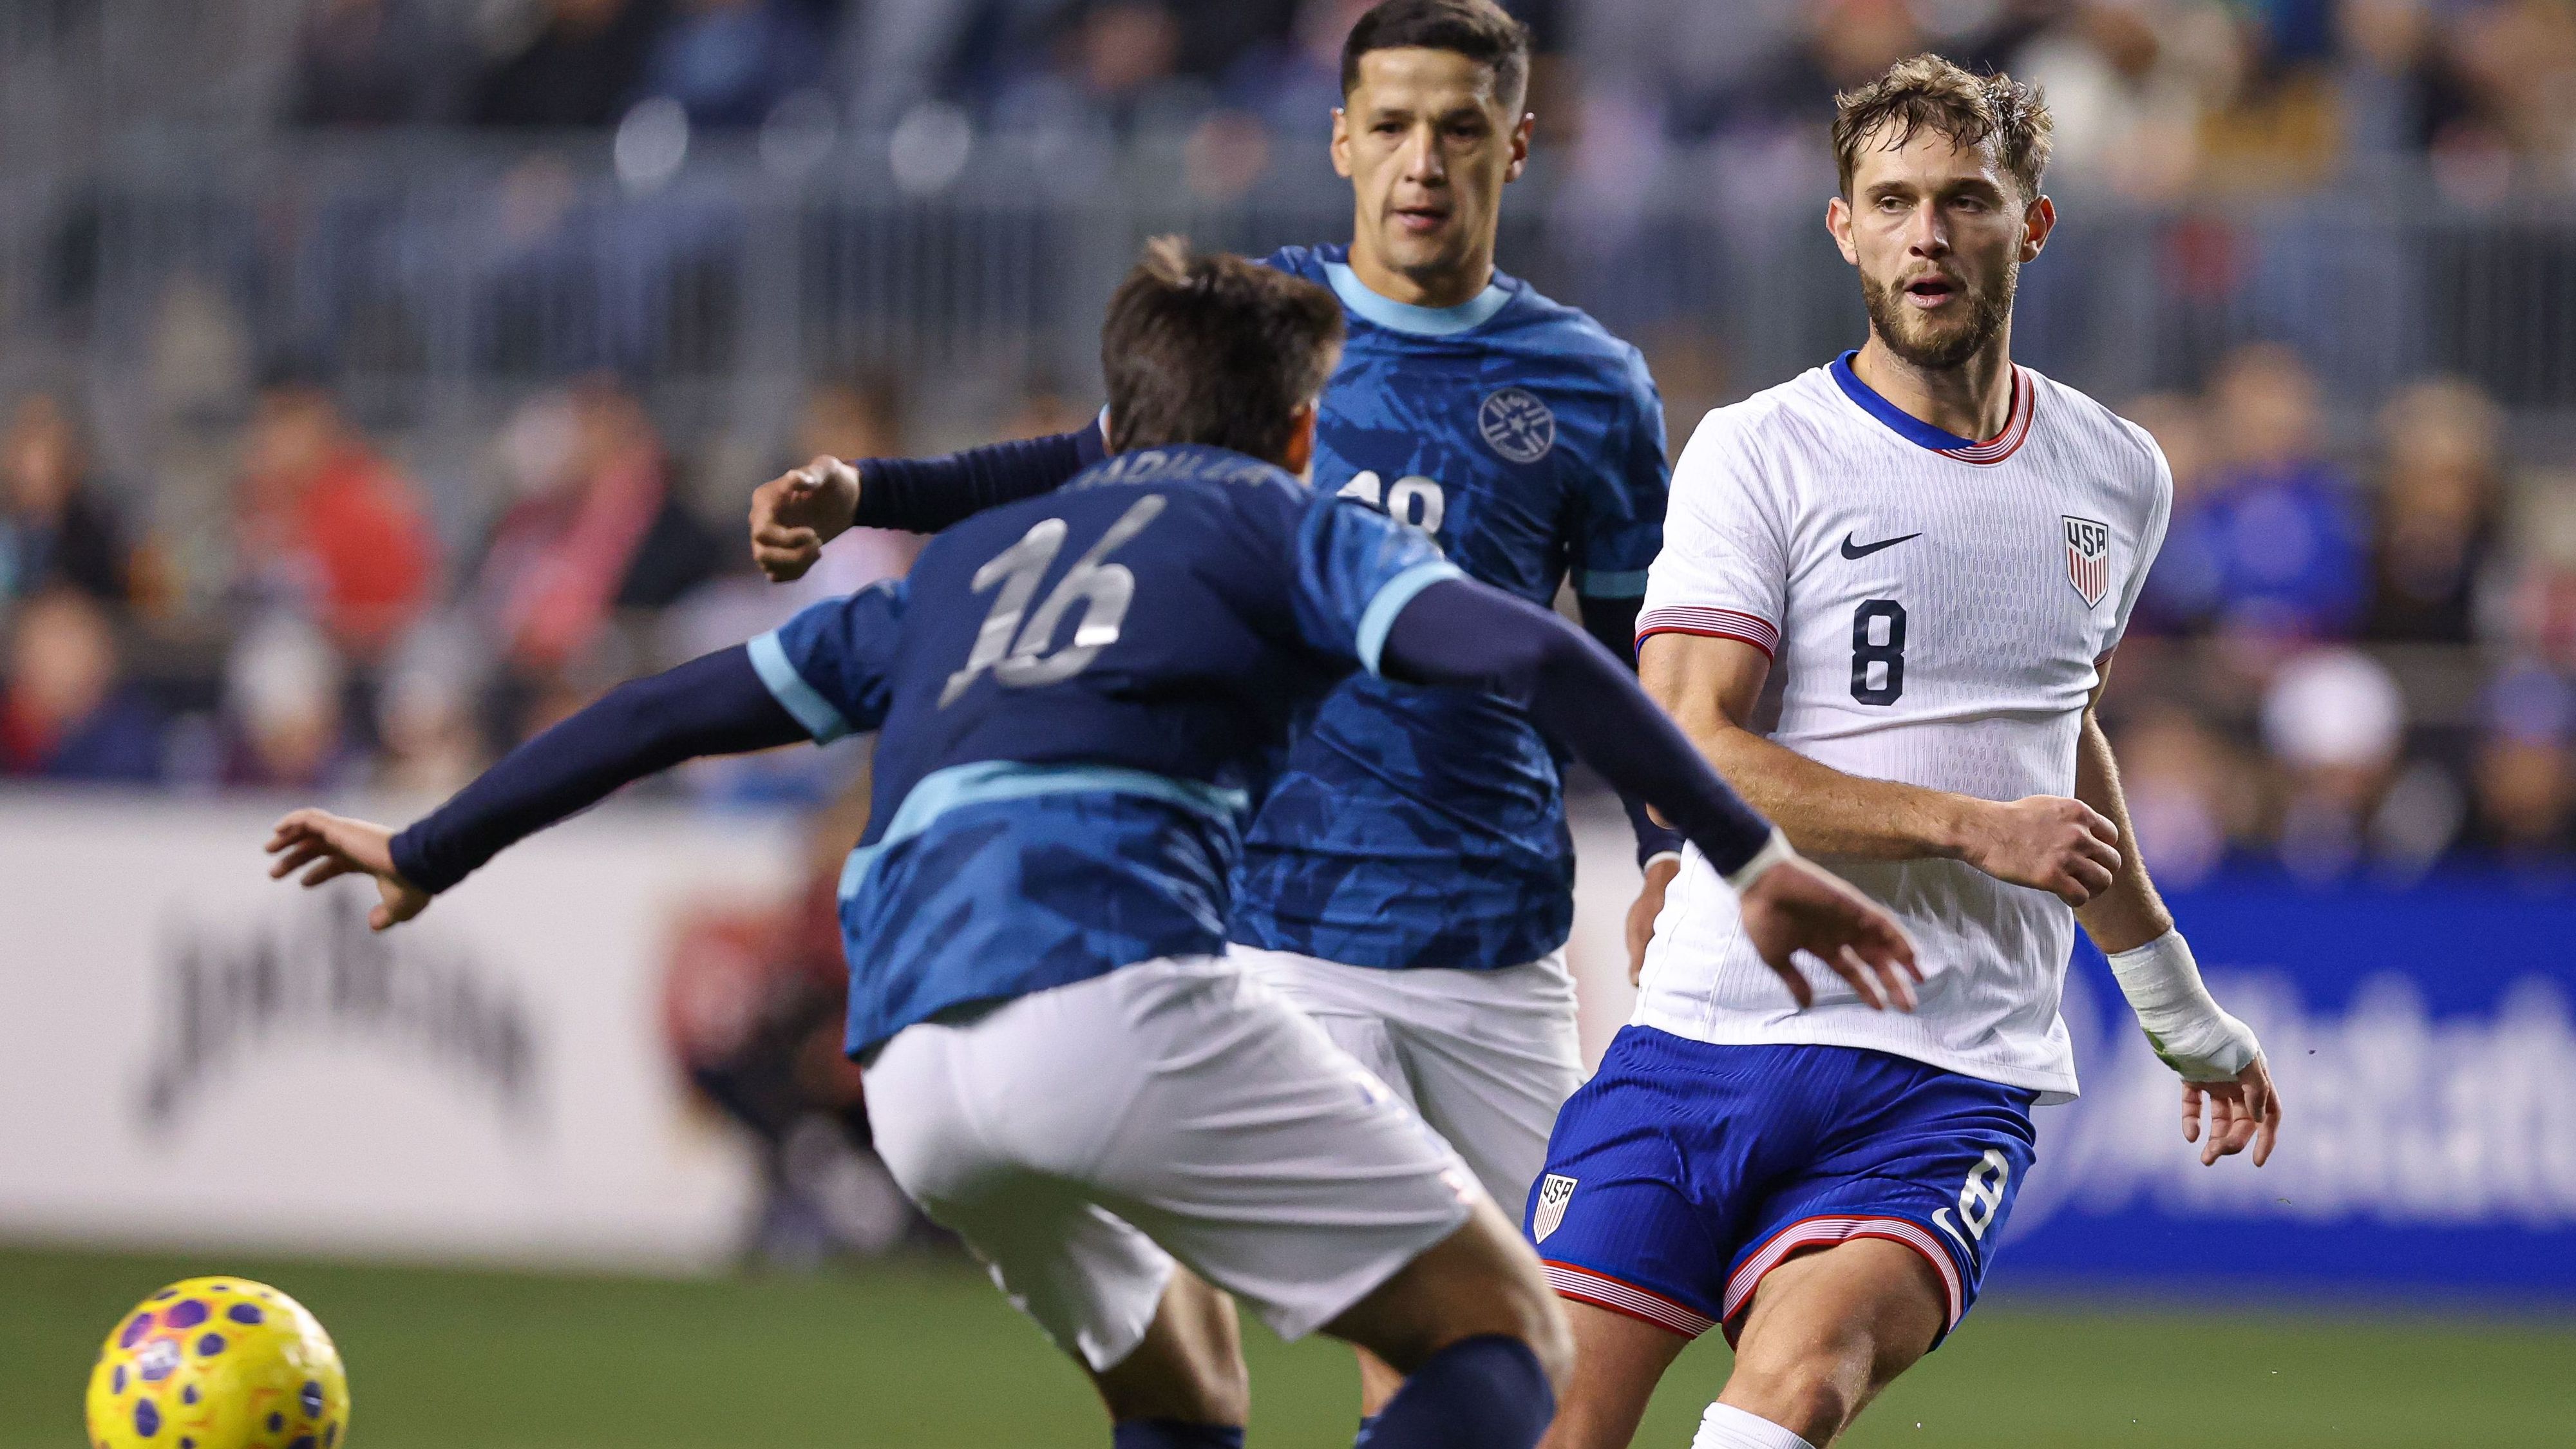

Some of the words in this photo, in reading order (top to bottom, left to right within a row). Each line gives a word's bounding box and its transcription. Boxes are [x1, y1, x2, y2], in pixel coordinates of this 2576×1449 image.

[2067, 521, 2106, 558] USA
[937, 493, 1168, 710] 16
[1850, 599, 1906, 706] 8
[1544, 1177, 1574, 1204] USA
[1958, 1148, 2009, 1240] 8
